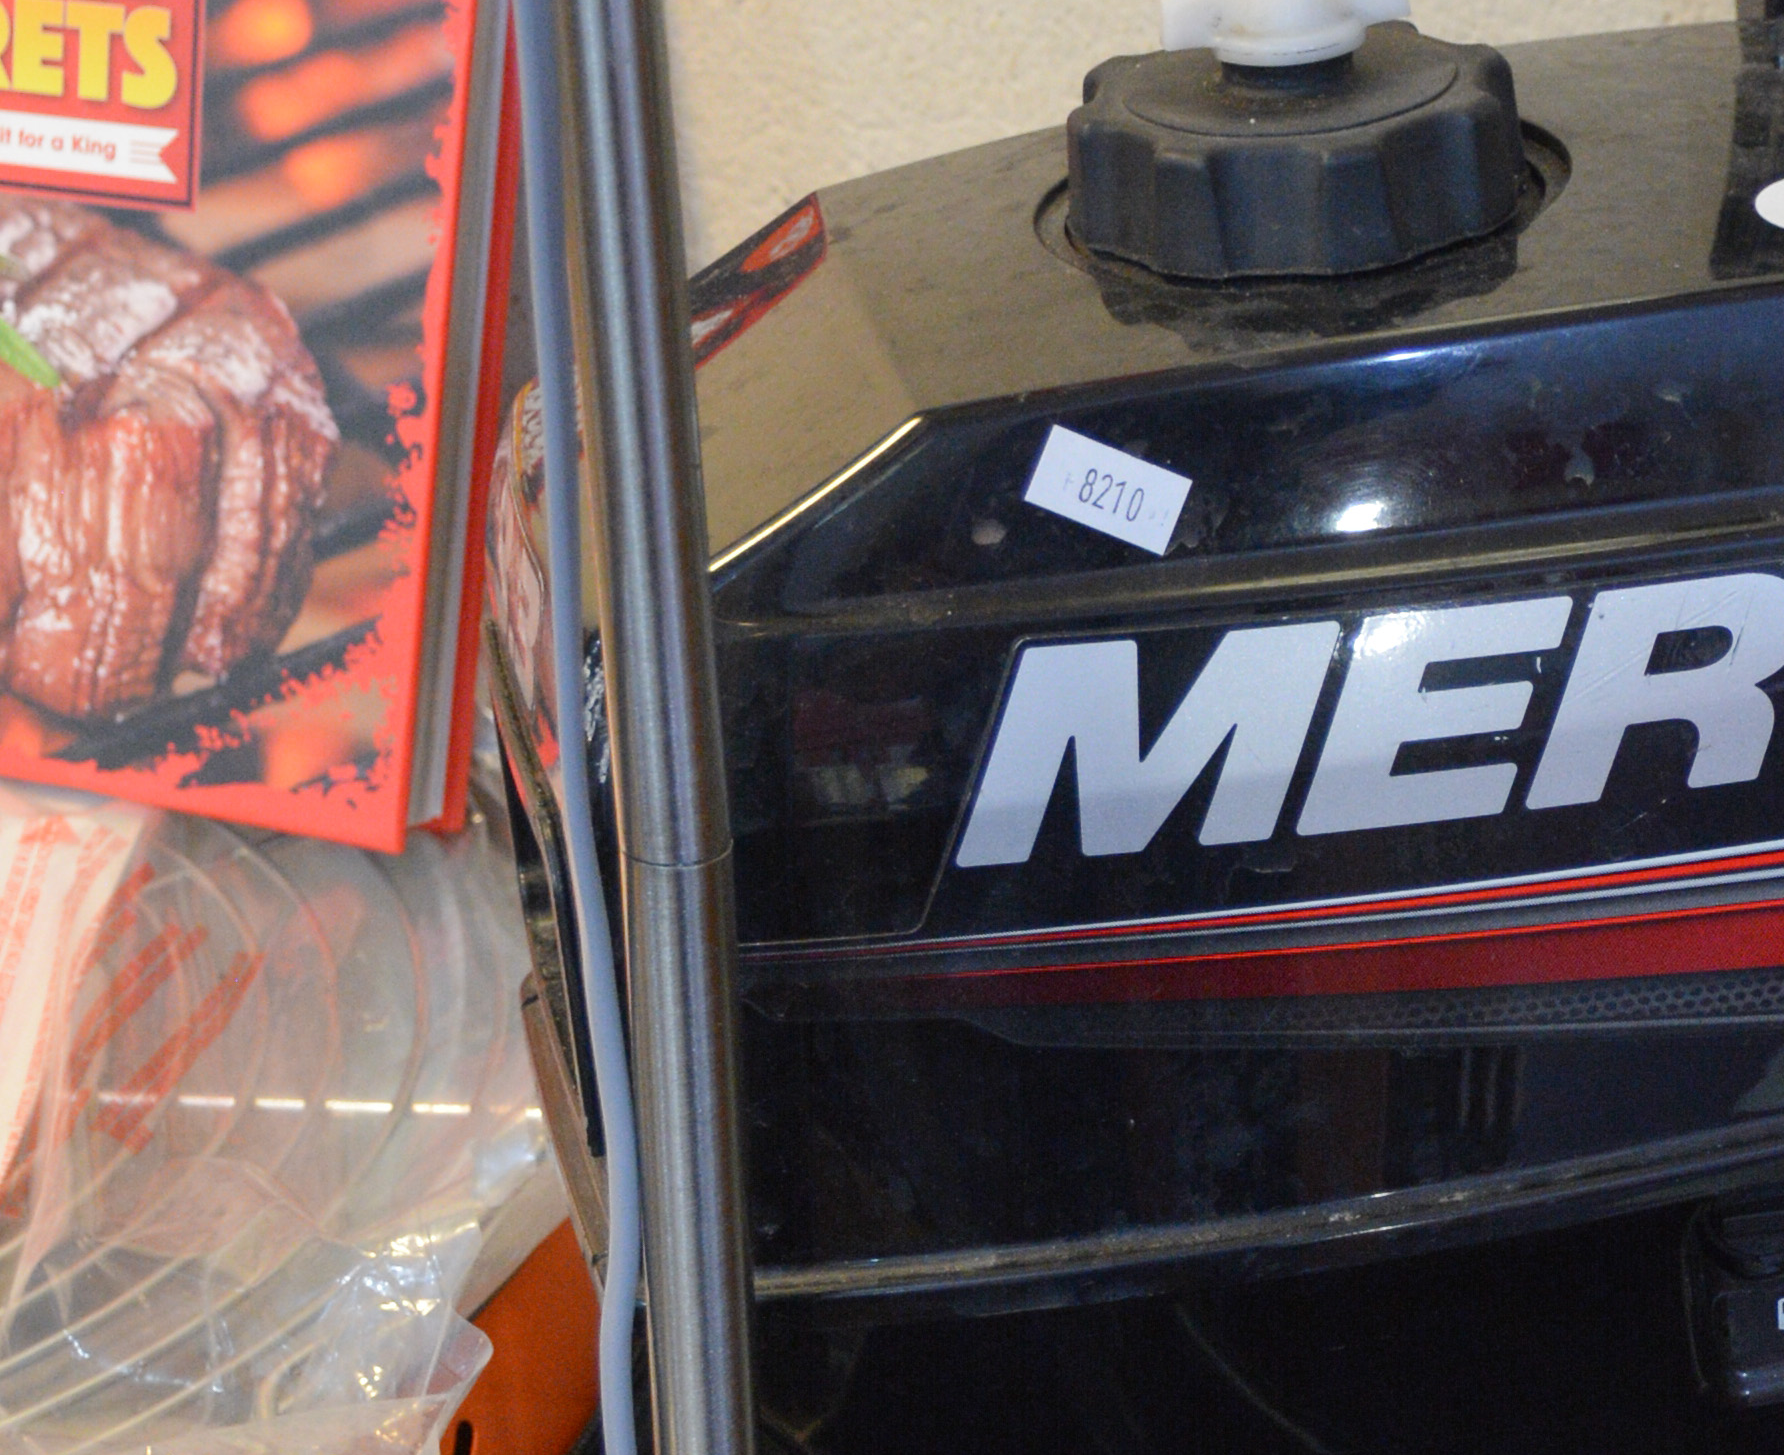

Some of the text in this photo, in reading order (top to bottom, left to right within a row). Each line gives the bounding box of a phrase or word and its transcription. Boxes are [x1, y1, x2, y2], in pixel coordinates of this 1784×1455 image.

[18, 128, 44, 148] for
[51, 135, 64, 152] a
[72, 134, 117, 163] King
[1078, 468, 1146, 523] 8210
